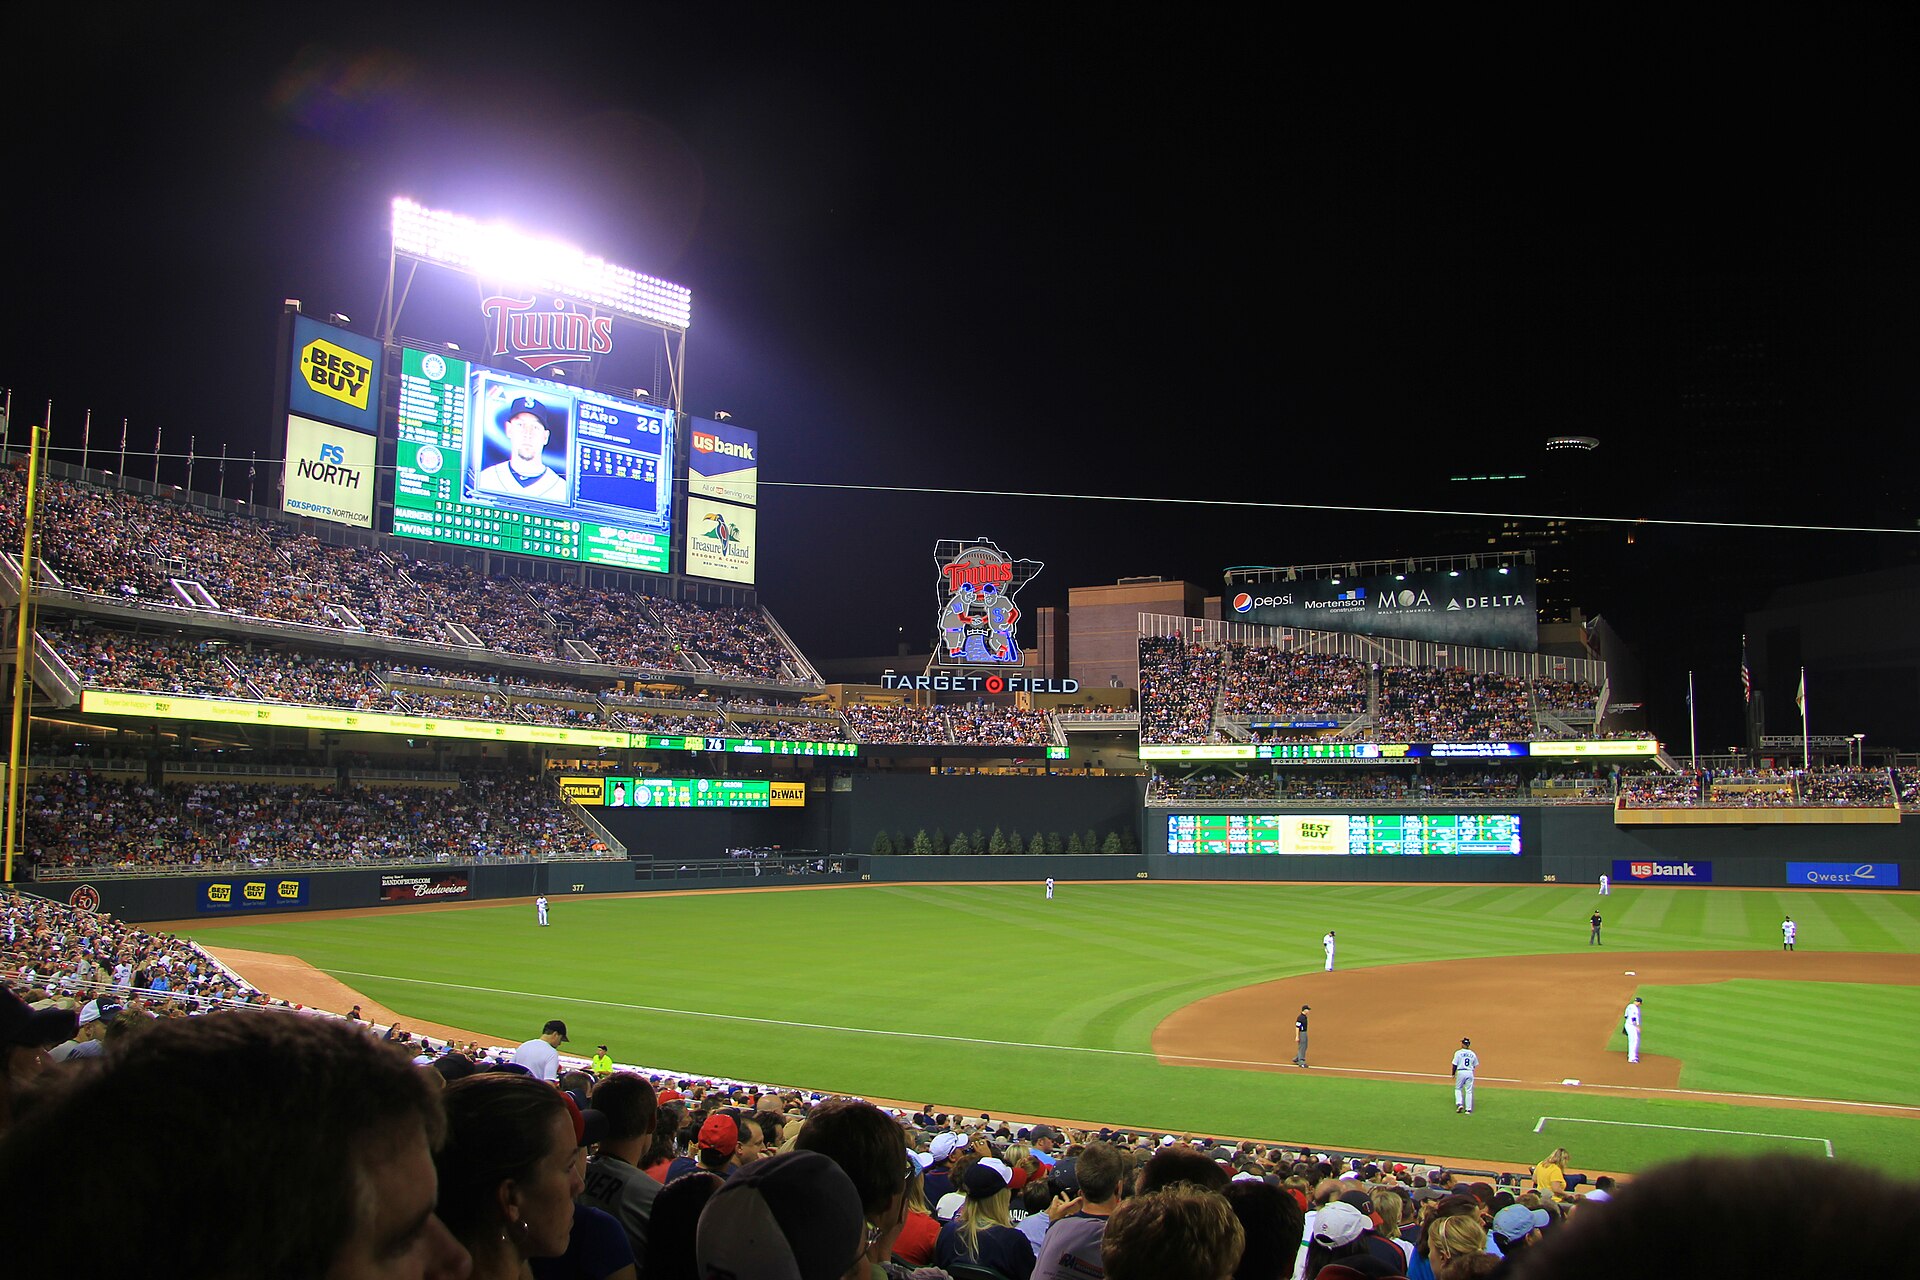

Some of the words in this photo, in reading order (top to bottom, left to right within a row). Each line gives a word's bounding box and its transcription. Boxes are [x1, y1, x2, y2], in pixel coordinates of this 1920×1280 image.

[482, 296, 614, 355] Twins
[311, 347, 370, 383] BEST
[311, 366, 366, 398] BUY
[580, 409, 619, 425] BARD
[636, 416, 661, 435] 26
[319, 443, 345, 465] FS
[297, 458, 361, 489] NORTH
[436, 501, 442, 510] 1
[445, 502, 453, 511] 2
[455, 504, 462, 513] 3
[465, 506, 472, 514] 4
[475, 507, 482, 516] 5
[484, 509, 491, 517] 6
[493, 510, 500, 518] 7
[544, 518, 551, 527] E
[563, 521, 571, 531] B
[571, 521, 580, 533] 0
[394, 522, 433, 536] TWINS
[571, 547, 578, 558] 1
[562, 534, 570, 544] S
[572, 534, 579, 545] 1
[691, 536, 722, 555] Treasure
[728, 543, 750, 559] Island
[692, 552, 716, 560] RESORT
[726, 557, 749, 565] CASINO
[943, 560, 1012, 591] Twins
[1254, 593, 1293, 608] pepsi
[1304, 599, 1365, 610] Mortenson
[1465, 594, 1526, 609] DELTA
[1329, 606, 1366, 614] construction
[882, 675, 982, 691] TARGET
[1008, 678, 1079, 693] FIELD
[708, 738, 721, 750] 76
[565, 786, 600, 797] STANLEY
[1301, 822, 1330, 832] BEST
[1301, 830, 1327, 839] BUY
[1631, 862, 1696, 876] usbank
[861, 873, 871, 881] 411
[1543, 874, 1556, 882] 365
[1806, 871, 1851, 883] Qwest
[412, 883, 467, 897] Budweiser
[572, 884, 585, 892] 377
[79, 895, 92, 909] 50
[1464, 1058, 1470, 1067] 8
